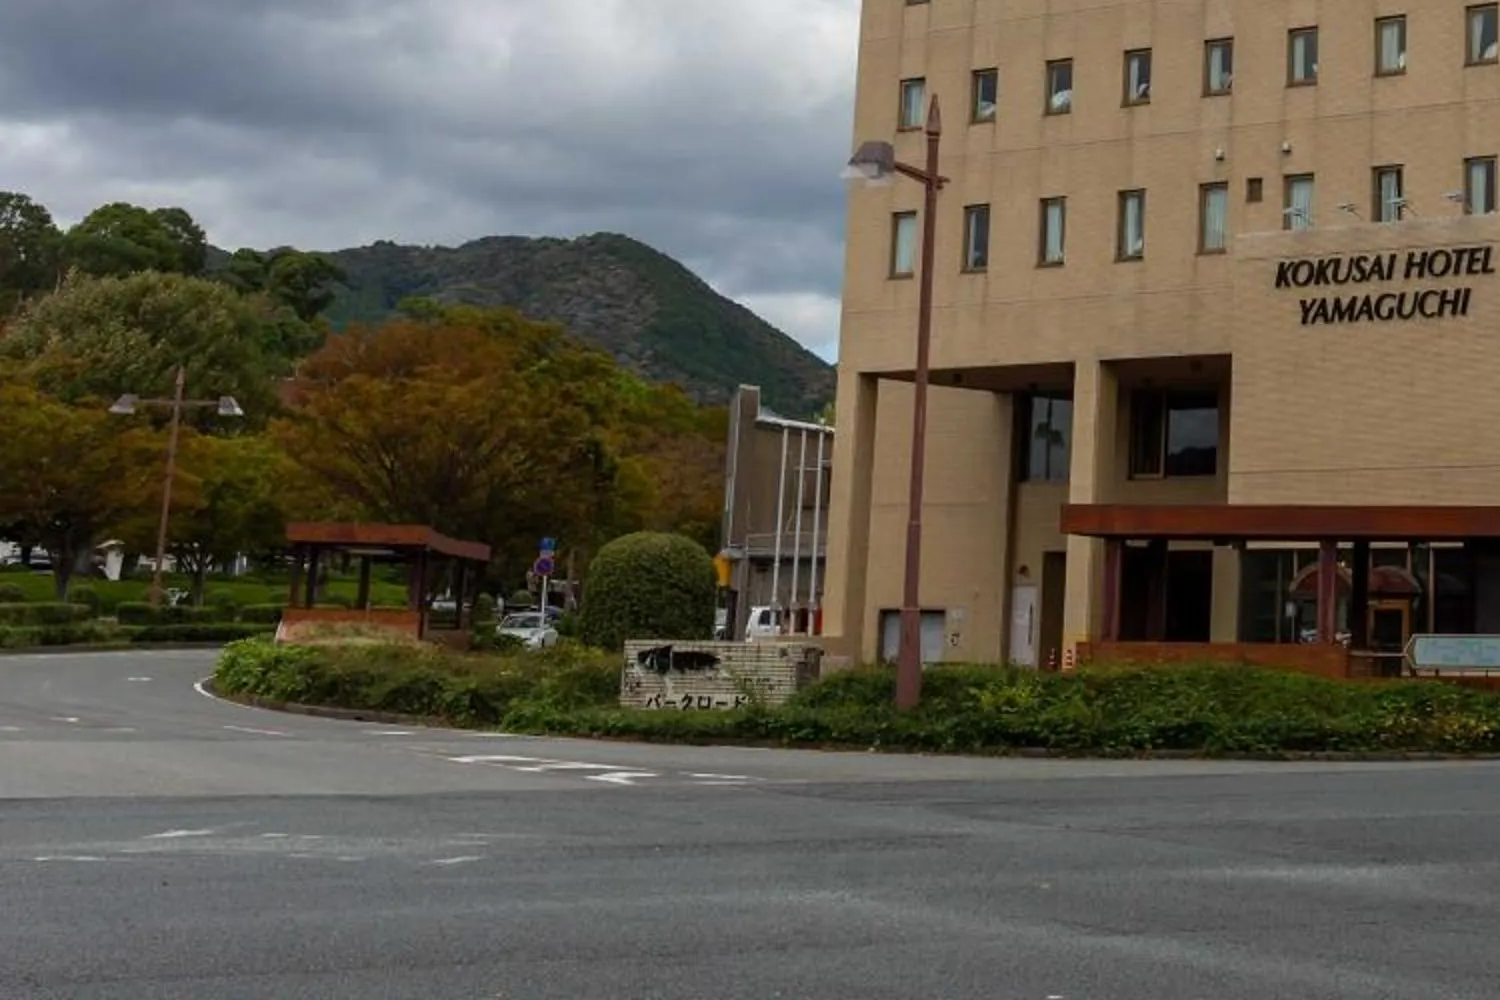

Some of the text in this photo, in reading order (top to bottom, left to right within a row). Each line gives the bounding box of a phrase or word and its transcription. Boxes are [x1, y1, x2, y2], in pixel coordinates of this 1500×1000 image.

[1275, 246, 1495, 288] KOKUSAI HOTEL
[1300, 288, 1472, 325] YAMAGUCHI
[645, 693, 747, 711] パークロード
